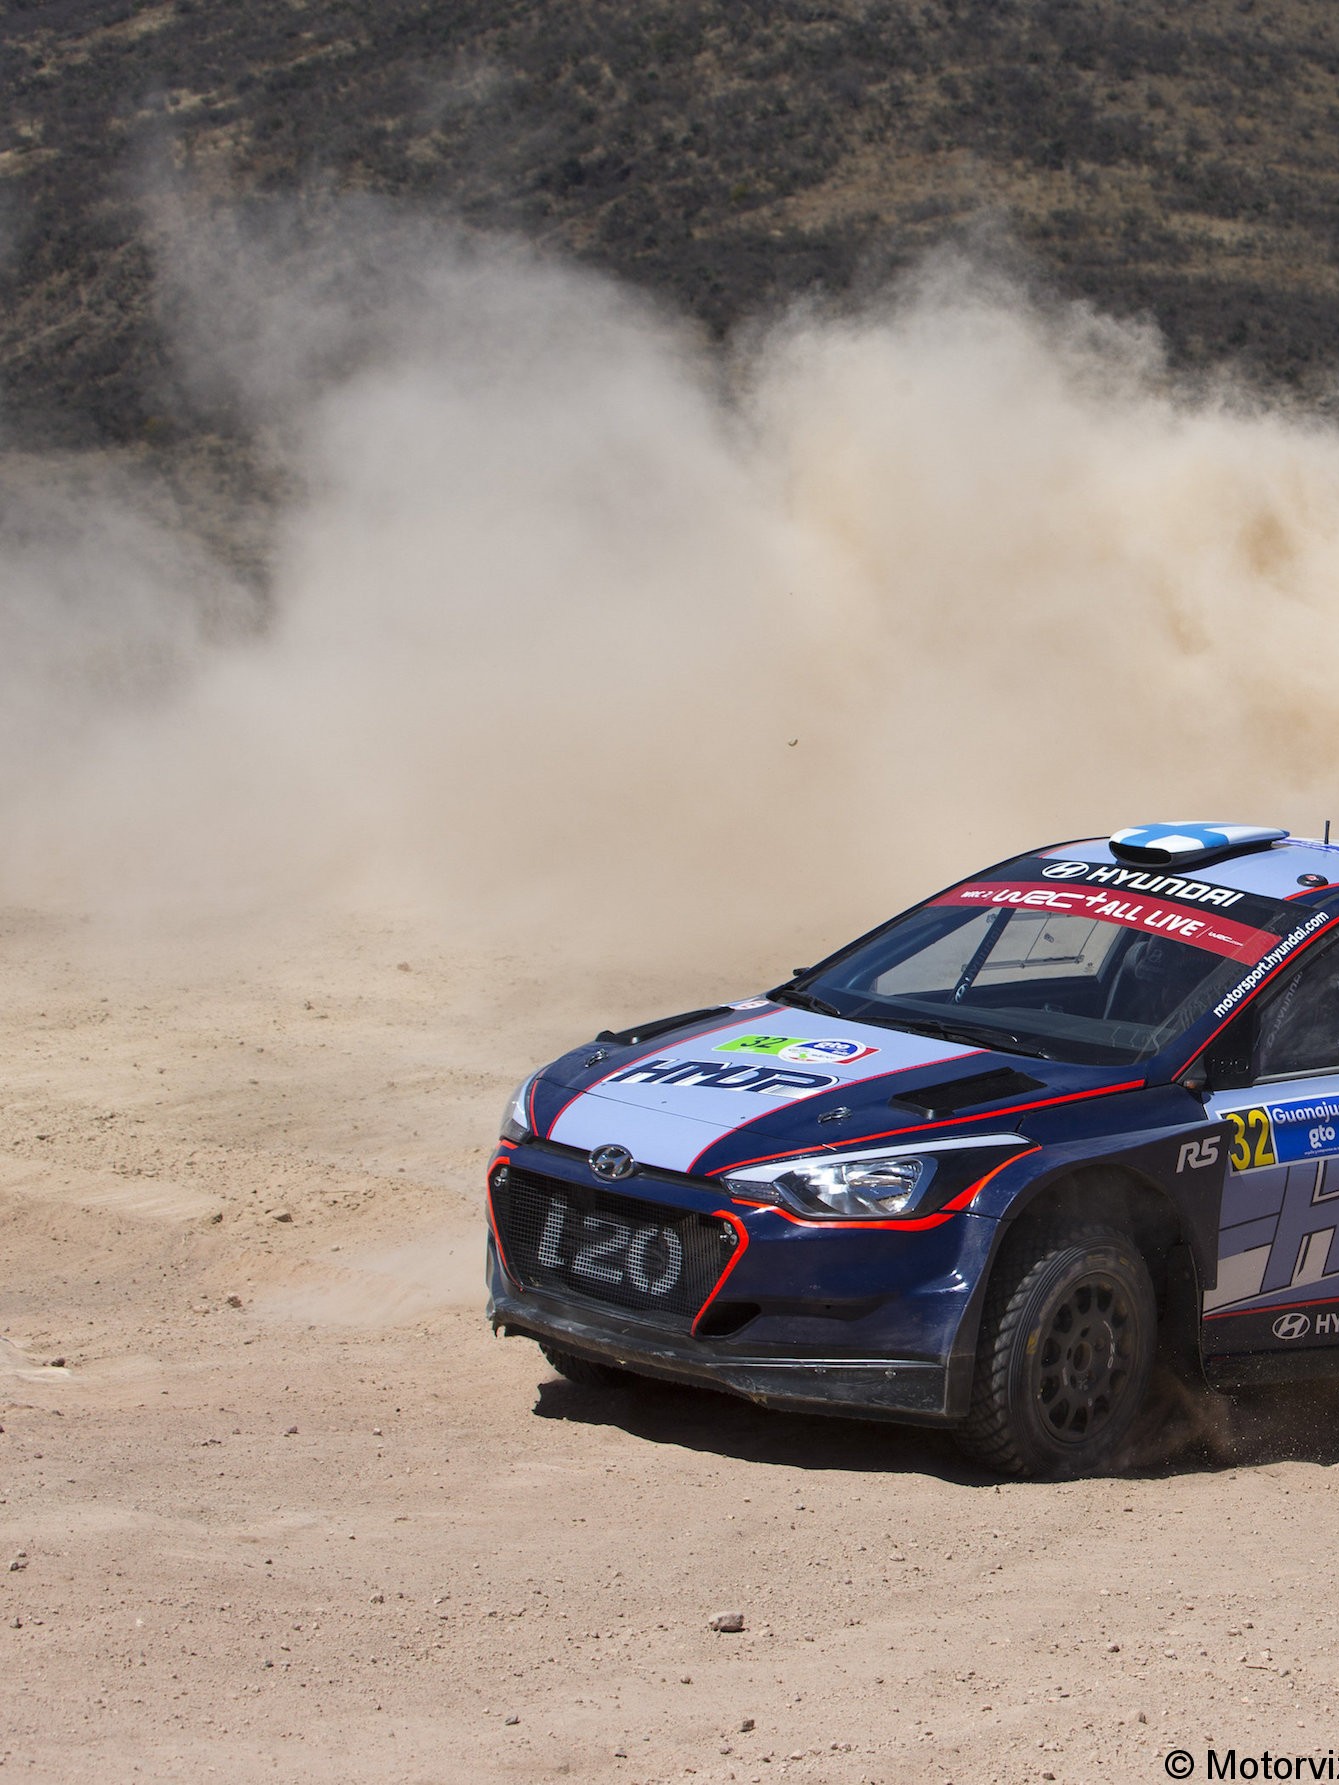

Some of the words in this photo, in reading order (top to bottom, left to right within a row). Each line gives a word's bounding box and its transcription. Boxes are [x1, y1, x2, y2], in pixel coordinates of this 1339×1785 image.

[1085, 866, 1245, 908] HYUNDAI
[1094, 900, 1143, 922] ALL
[1143, 910, 1206, 937] LIVE
[1213, 911, 1329, 1018] motorsport.hyundai.com
[740, 1036, 789, 1049] 32
[1176, 1136, 1221, 1173] R5
[1226, 1109, 1275, 1170] 32
[1308, 1125, 1336, 1149] gto
